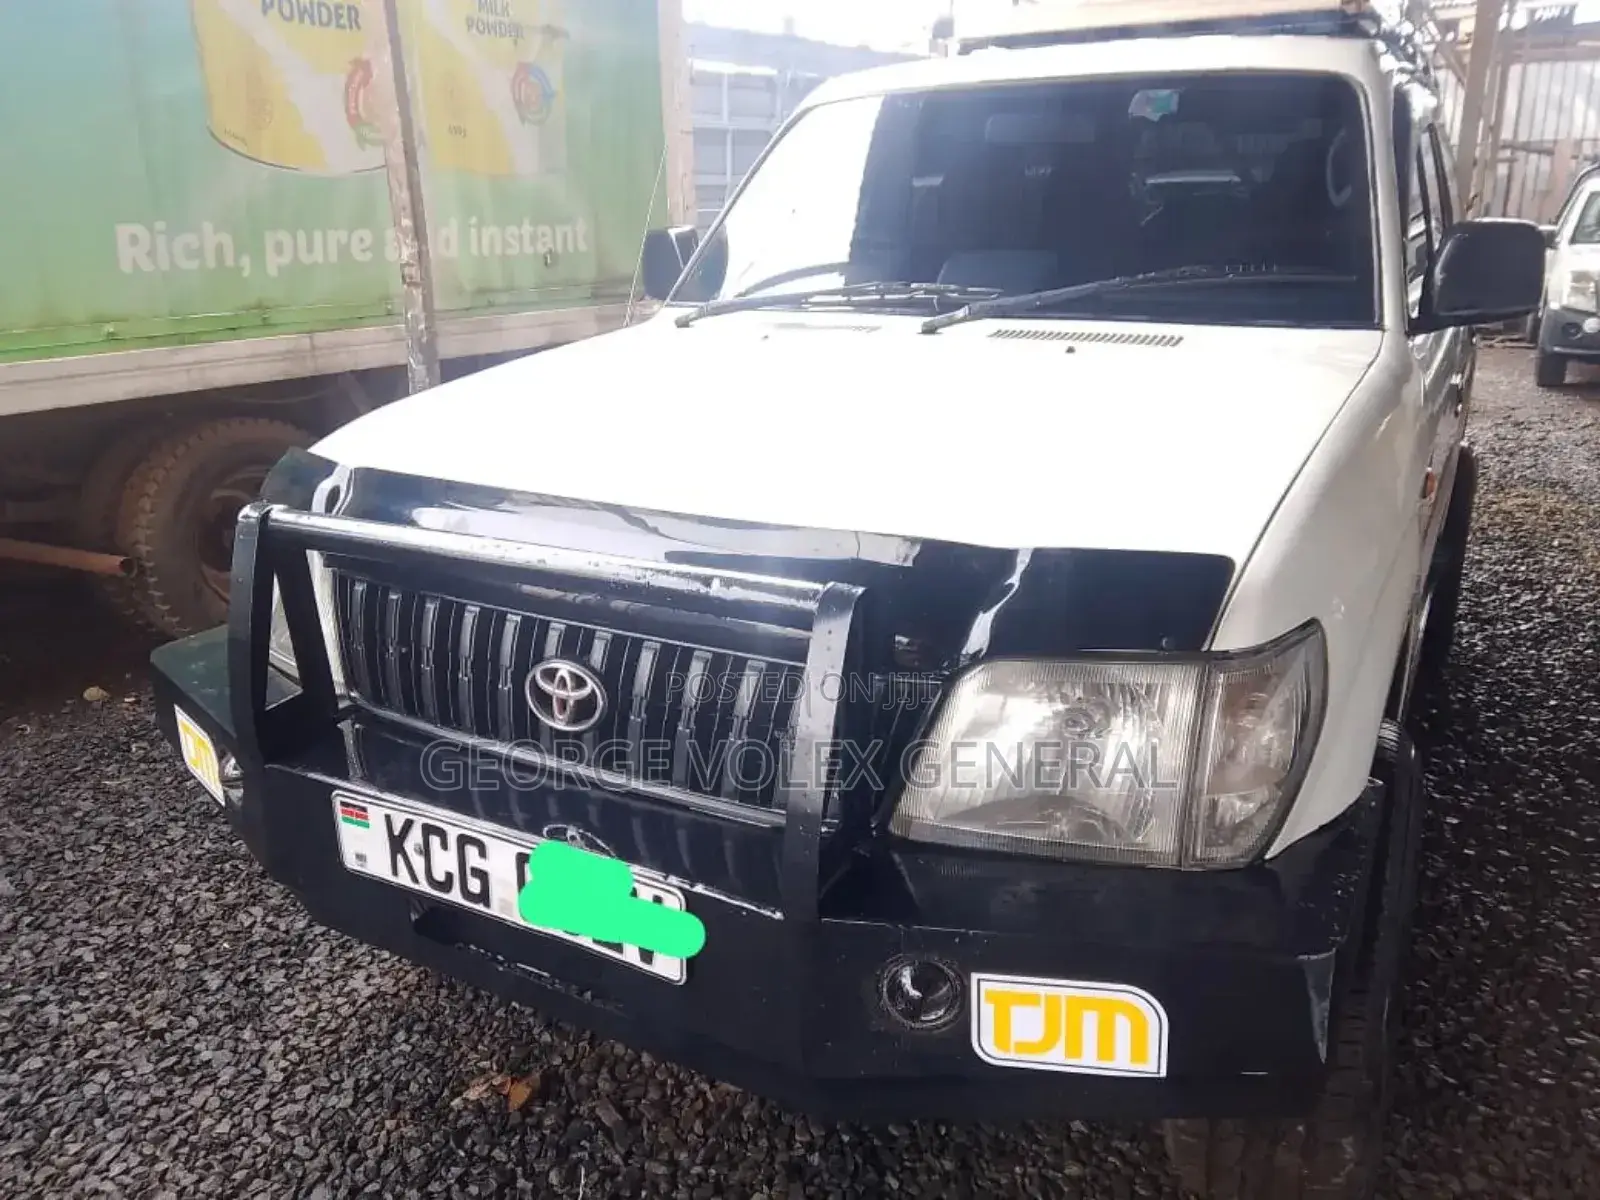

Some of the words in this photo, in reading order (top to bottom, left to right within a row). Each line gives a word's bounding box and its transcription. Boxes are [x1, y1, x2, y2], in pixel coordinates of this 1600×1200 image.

[261, 0, 362, 31] POWDER
[466, 16, 525, 39] POWDER
[114, 220, 250, 278] Rich,
[264, 228, 373, 278] pure
[384, 217, 458, 263] ad
[468, 216, 588, 258] instant
[384, 813, 491, 909] KCG
[984, 989, 1150, 1065] TJM
